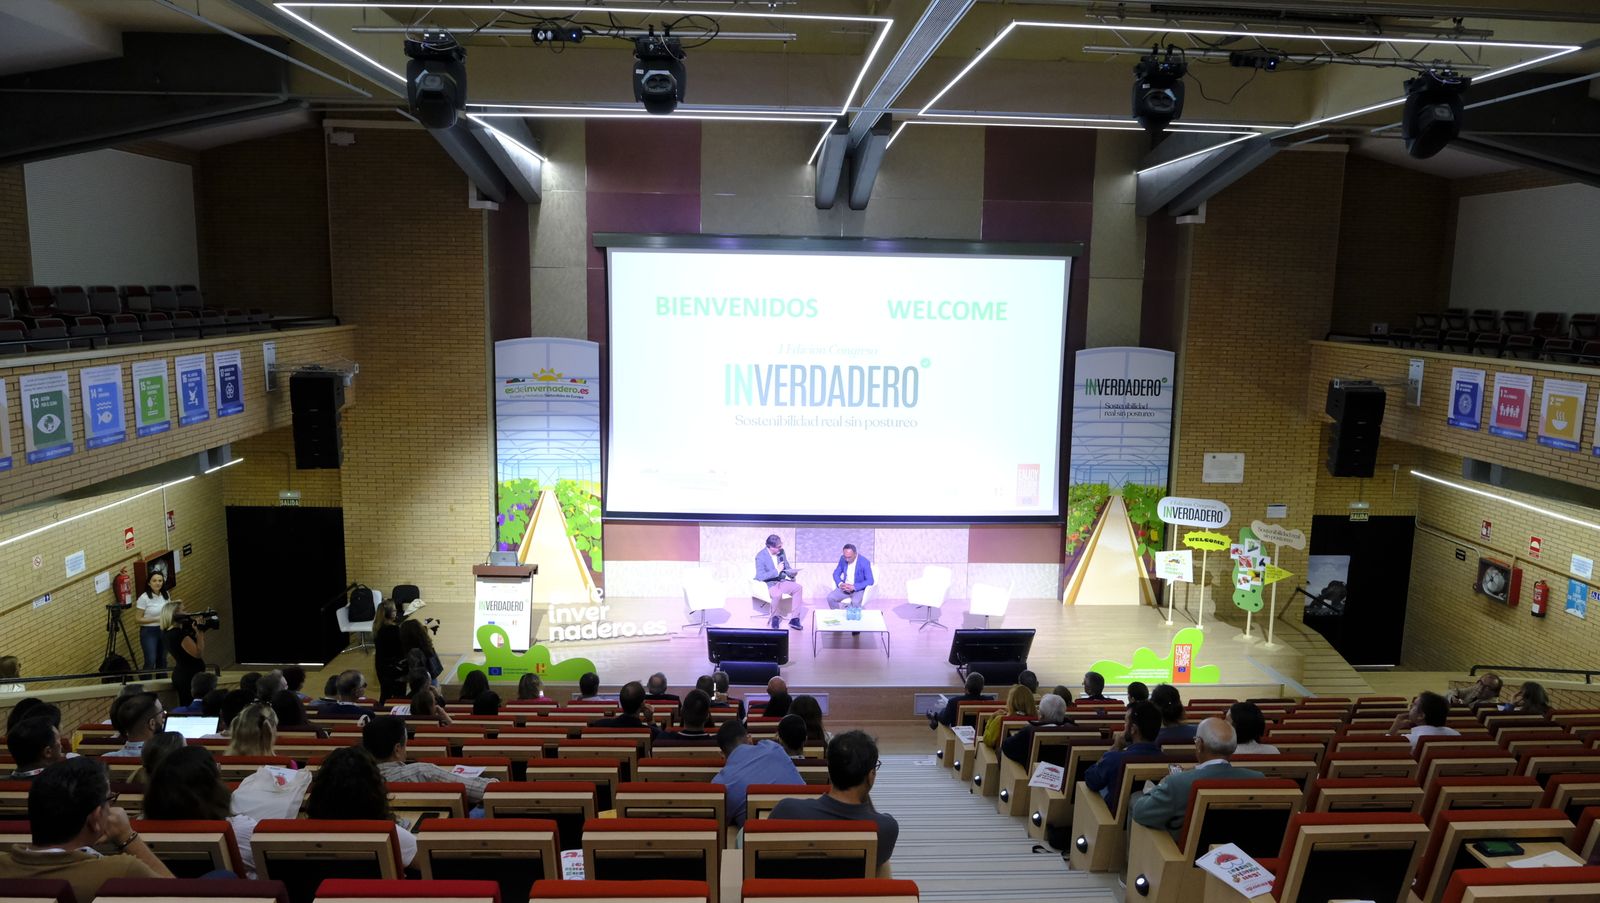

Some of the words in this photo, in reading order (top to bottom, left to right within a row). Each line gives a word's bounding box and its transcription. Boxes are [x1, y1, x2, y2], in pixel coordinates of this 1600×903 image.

[656, 296, 817, 318] BIENVENIDOS
[887, 299, 1008, 321] WELCOME
[724, 363, 919, 408] INVERDADERO
[1085, 378, 1162, 397] INVERDADERO
[32, 397, 40, 409] 13
[734, 415, 819, 428] Sostenibilidad
[821, 416, 843, 428] real
[845, 416, 863, 428] sin
[865, 418, 918, 431] postureo
[1163, 505, 1224, 524] INVERDADERO
[1188, 537, 1225, 546] WELCOME
[478, 600, 524, 612] INVERDADERO
[548, 604, 610, 624] inver
[548, 619, 667, 641] nadero.es
